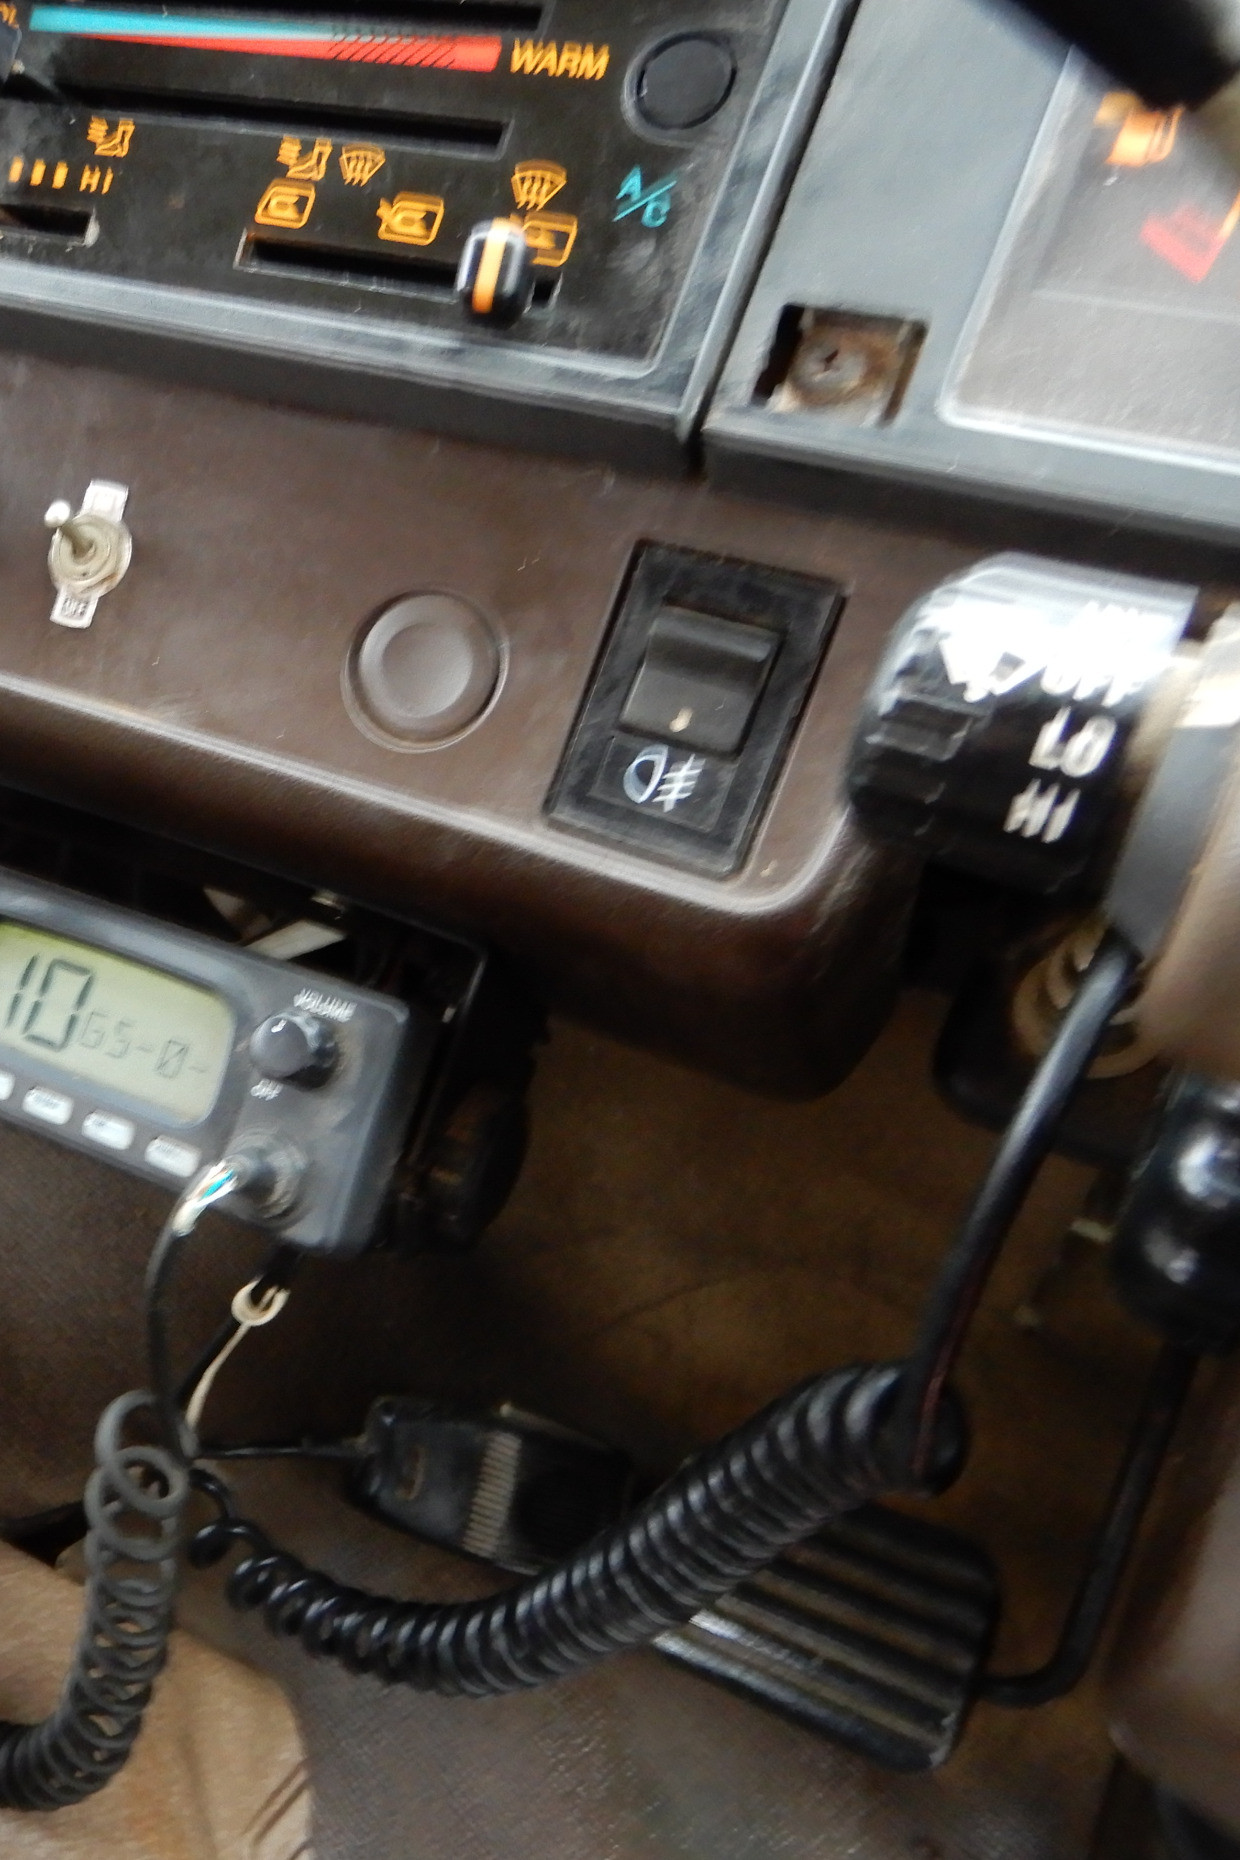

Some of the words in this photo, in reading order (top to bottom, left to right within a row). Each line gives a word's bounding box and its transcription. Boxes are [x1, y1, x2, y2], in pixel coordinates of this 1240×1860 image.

[510, 37, 610, 80] WARM
[613, 165, 678, 228] A/C
[5, 953, 96, 1052] 10
